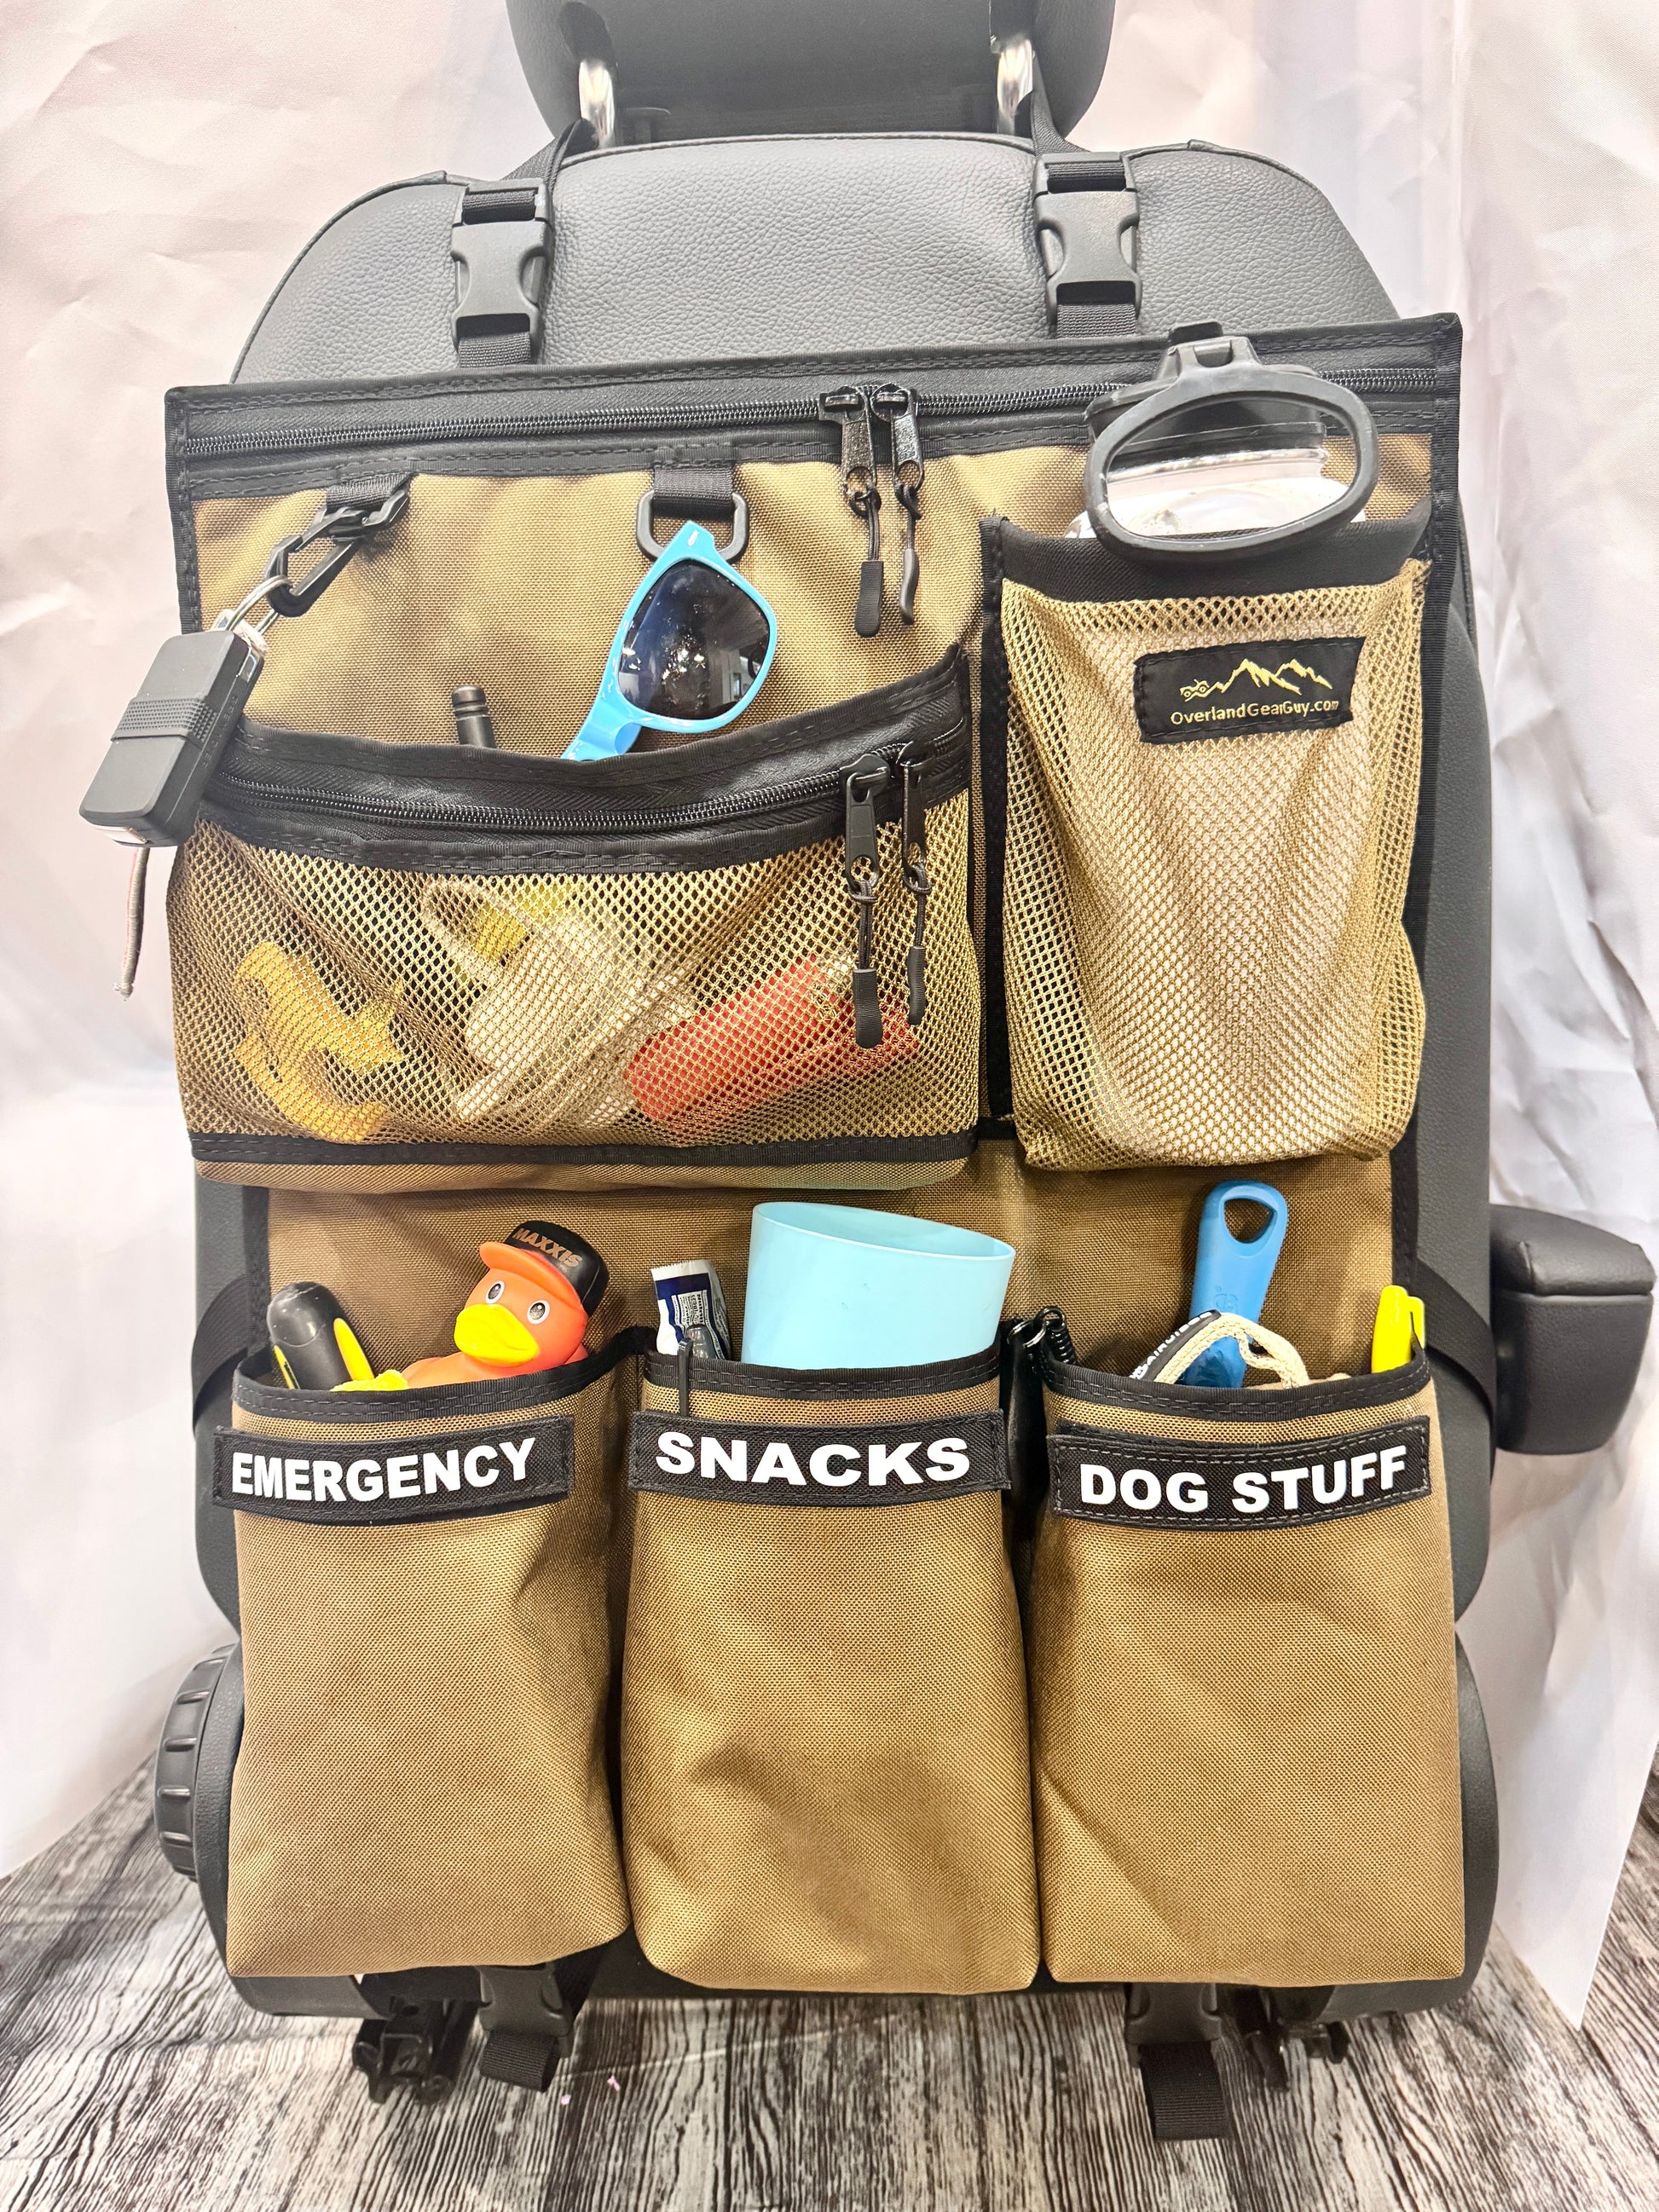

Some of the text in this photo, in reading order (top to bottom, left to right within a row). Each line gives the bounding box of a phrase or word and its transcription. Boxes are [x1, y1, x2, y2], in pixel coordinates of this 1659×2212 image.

[1171, 700, 1339, 725] OverlandGearGuy.com
[512, 1227, 583, 1268] MAXXIS
[232, 1437, 536, 1502] EMERGENCY
[656, 1431, 970, 1487] SNACKS
[1080, 1445, 1407, 1514] DOG STUFF
